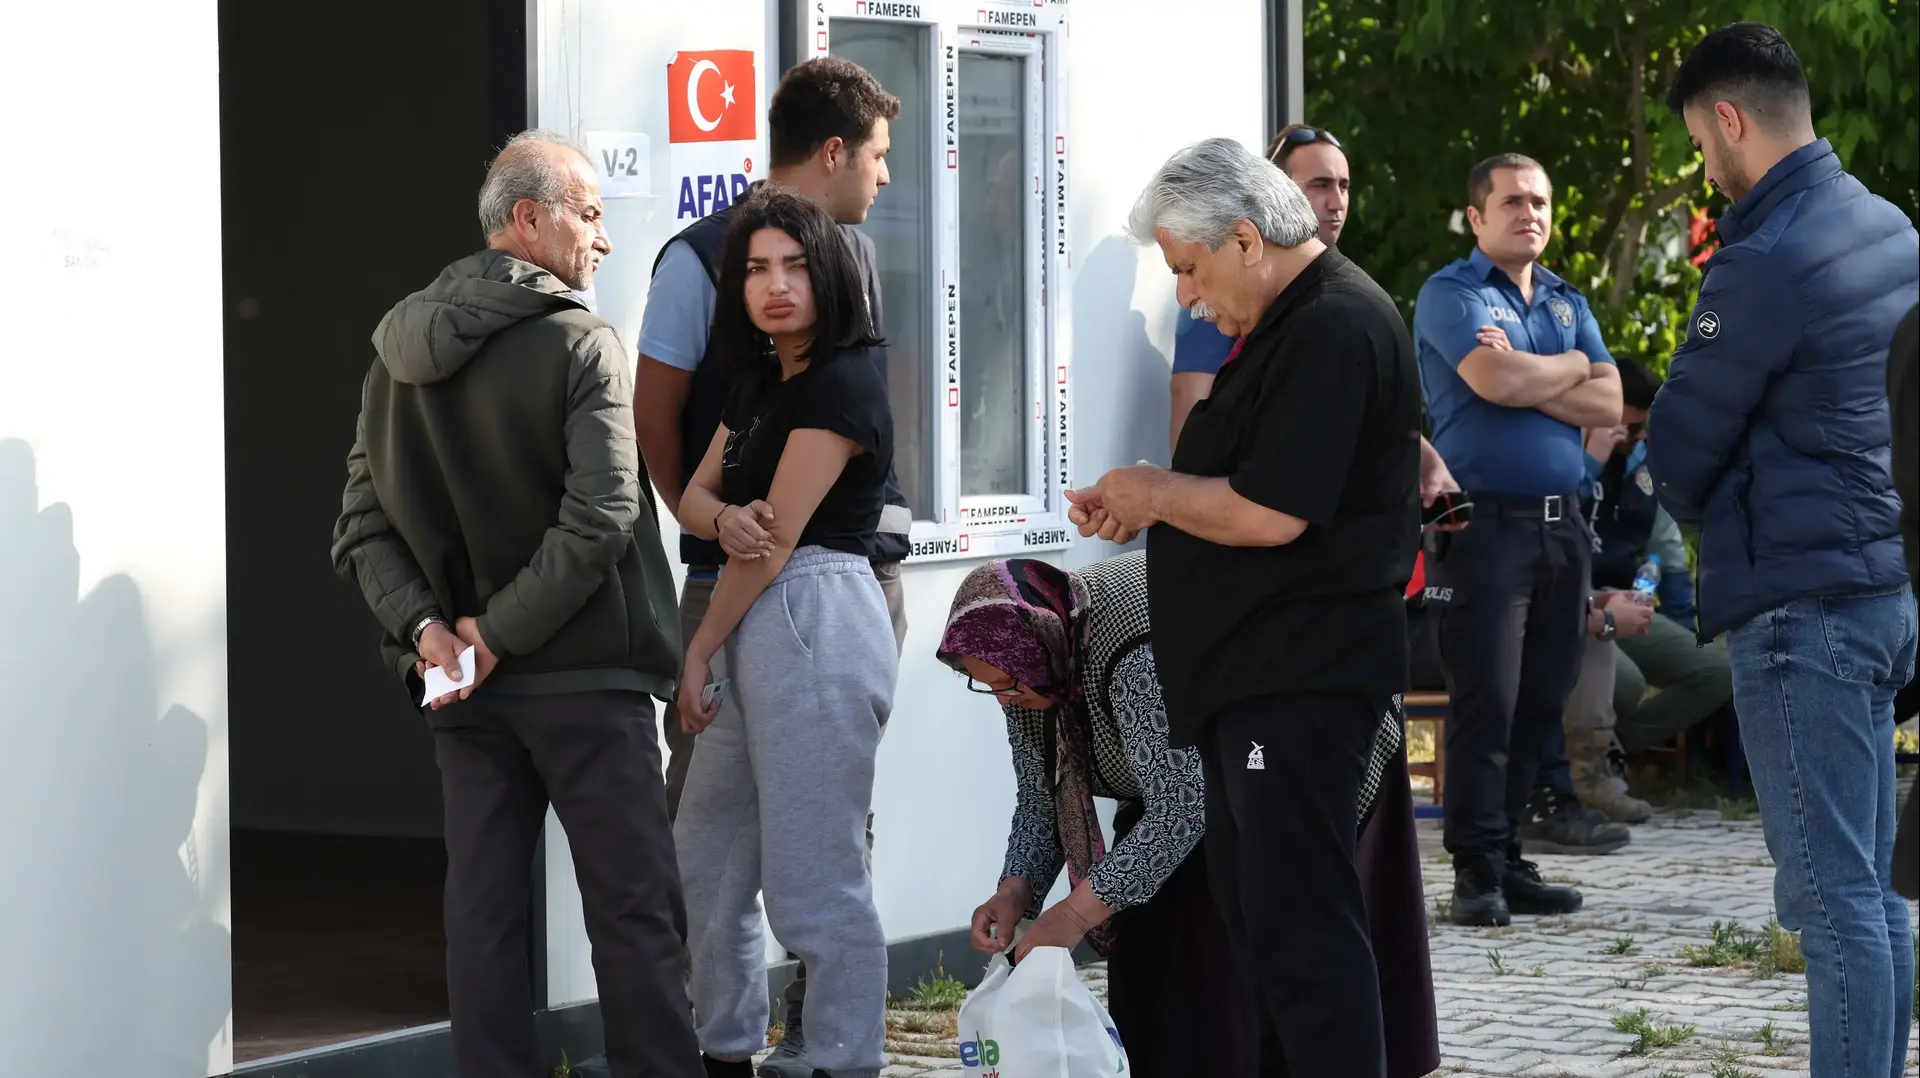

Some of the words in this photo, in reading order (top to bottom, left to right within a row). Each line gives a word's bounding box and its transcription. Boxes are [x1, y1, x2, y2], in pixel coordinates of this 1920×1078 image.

[868, 2, 920, 18] FAMEPEN
[988, 10, 1036, 27] FAMEPEN
[946, 46, 955, 146] FAMEPEN
[602, 147, 638, 178] V-2
[948, 284, 956, 384] FAMEPEN
[1059, 388, 1068, 485] FAMEPEN
